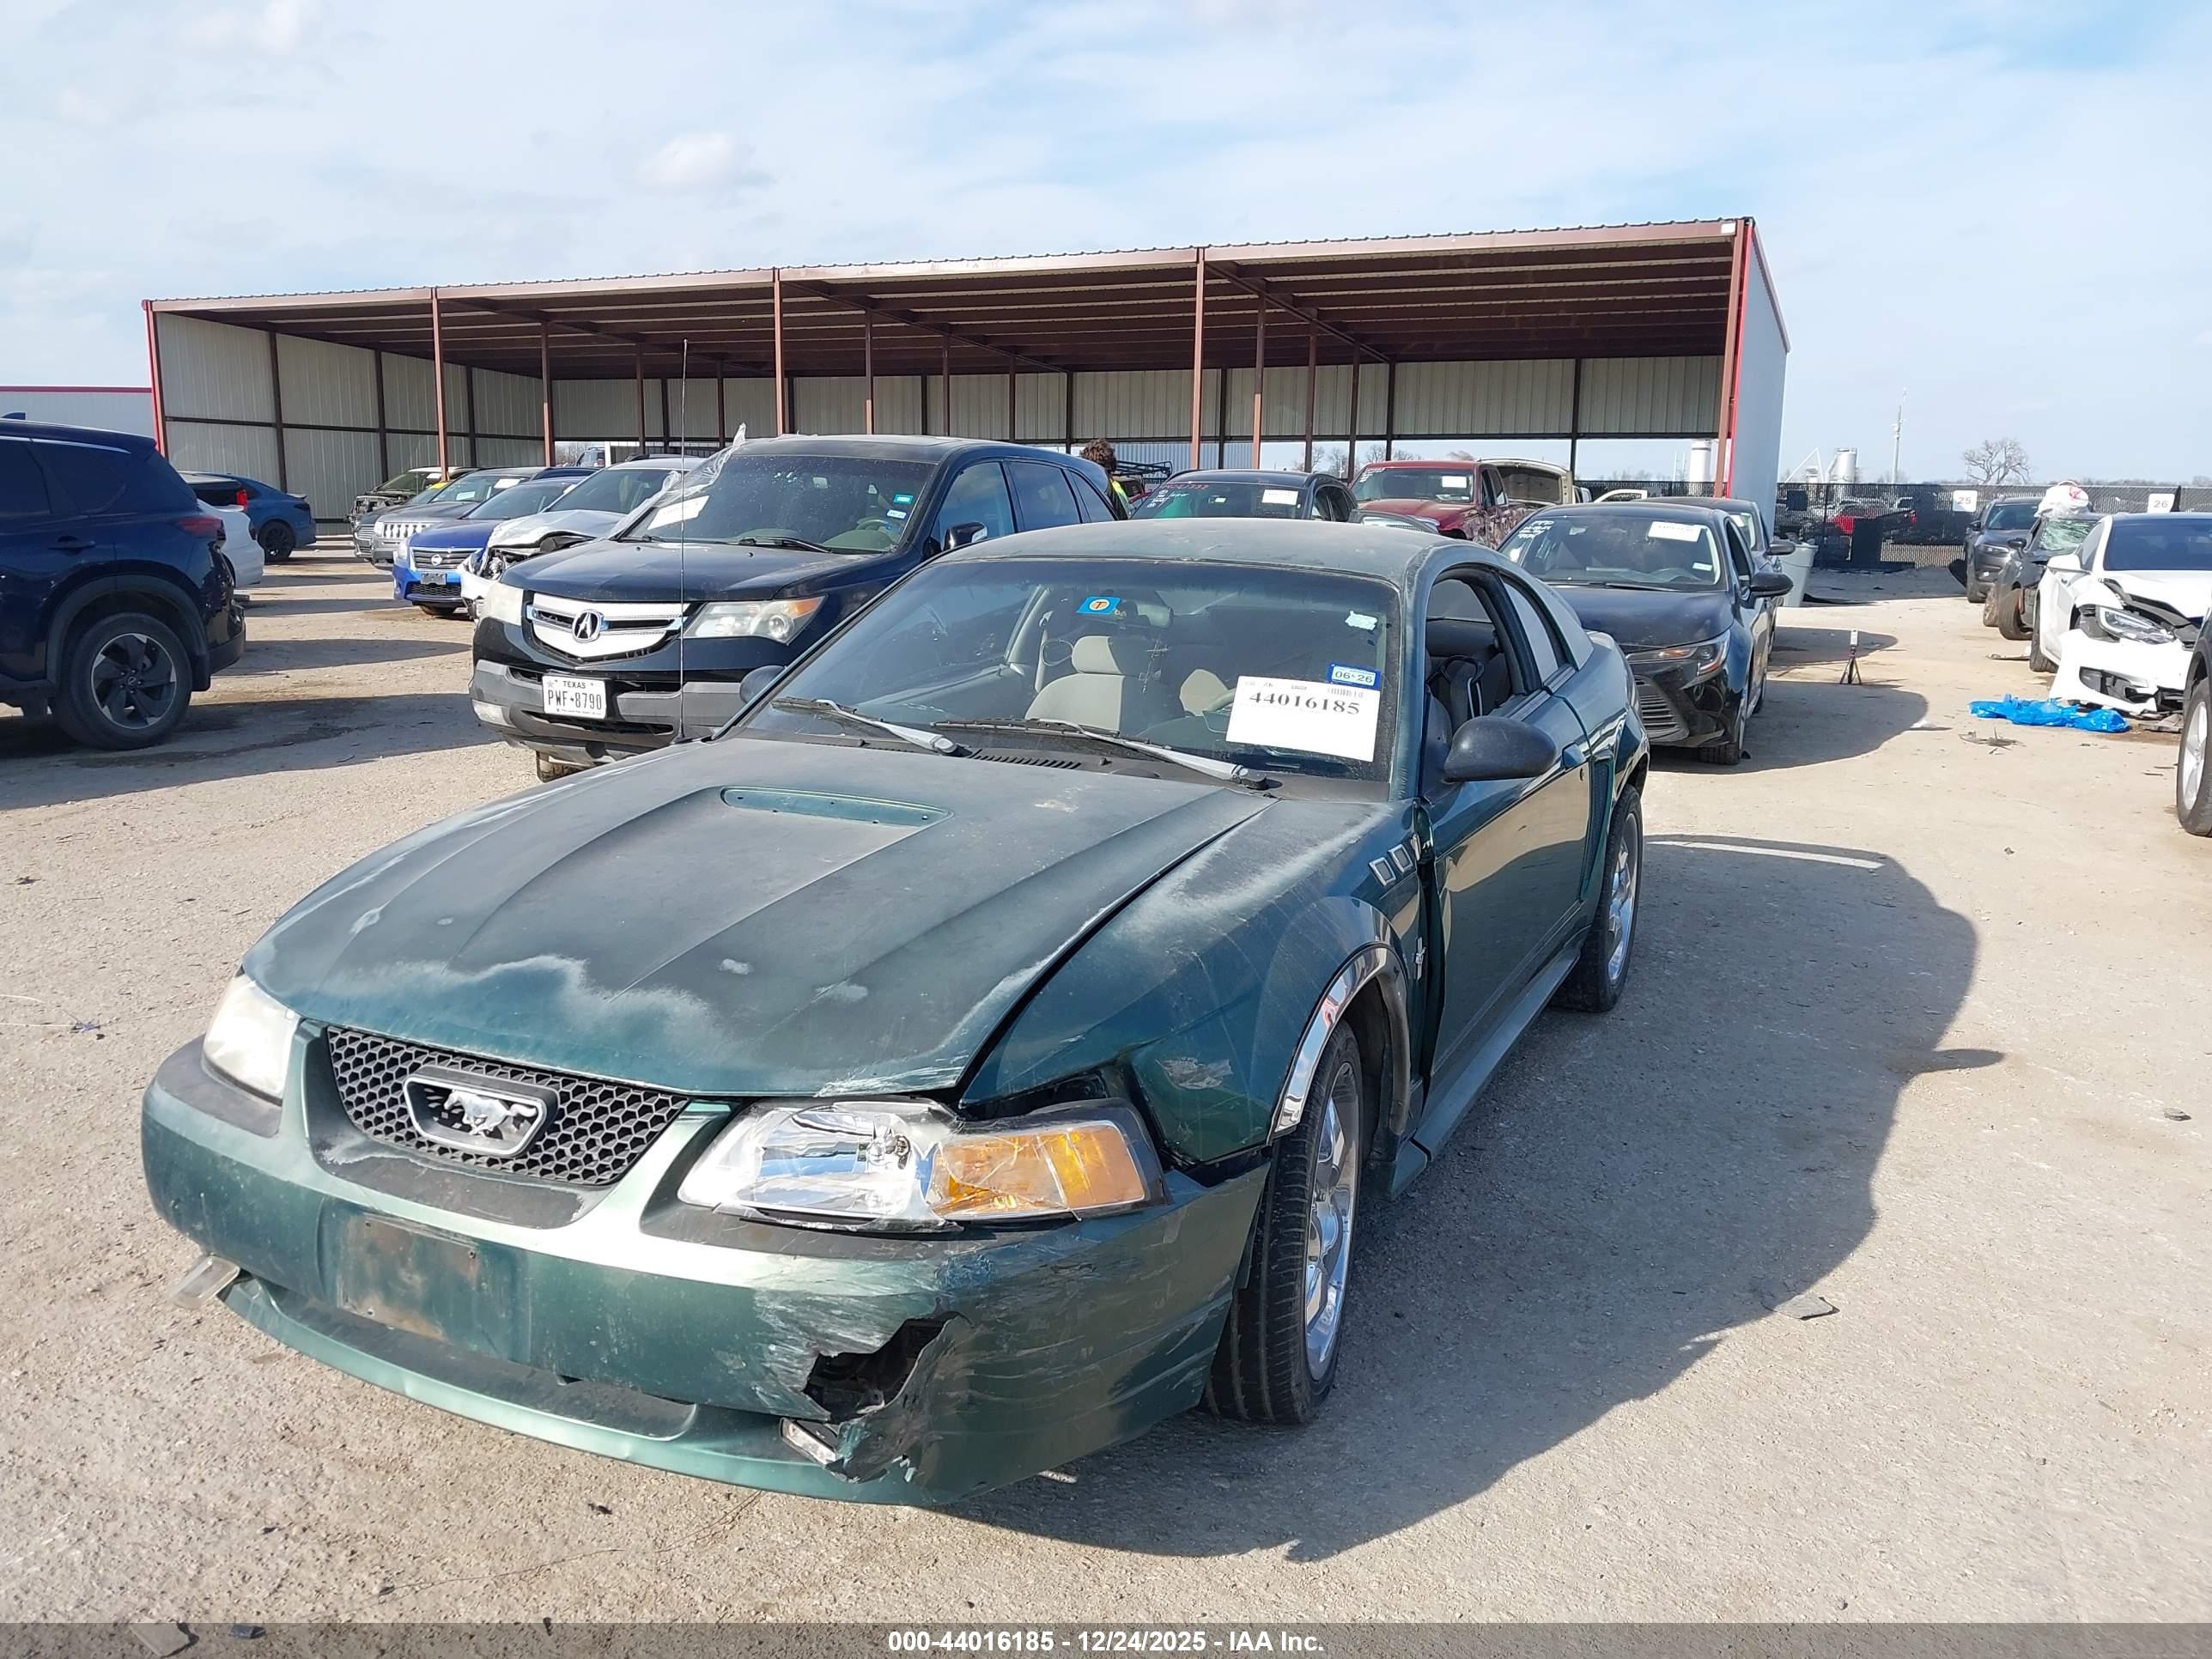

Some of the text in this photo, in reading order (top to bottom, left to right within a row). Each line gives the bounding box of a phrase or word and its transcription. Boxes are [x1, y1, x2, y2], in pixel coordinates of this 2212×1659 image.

[1958, 496, 1972, 505] 25
[2153, 500, 2169, 508] 26
[1335, 671, 1373, 684] 06 26
[562, 680, 586, 690] TEXAS
[1249, 691, 1361, 715] 44016185
